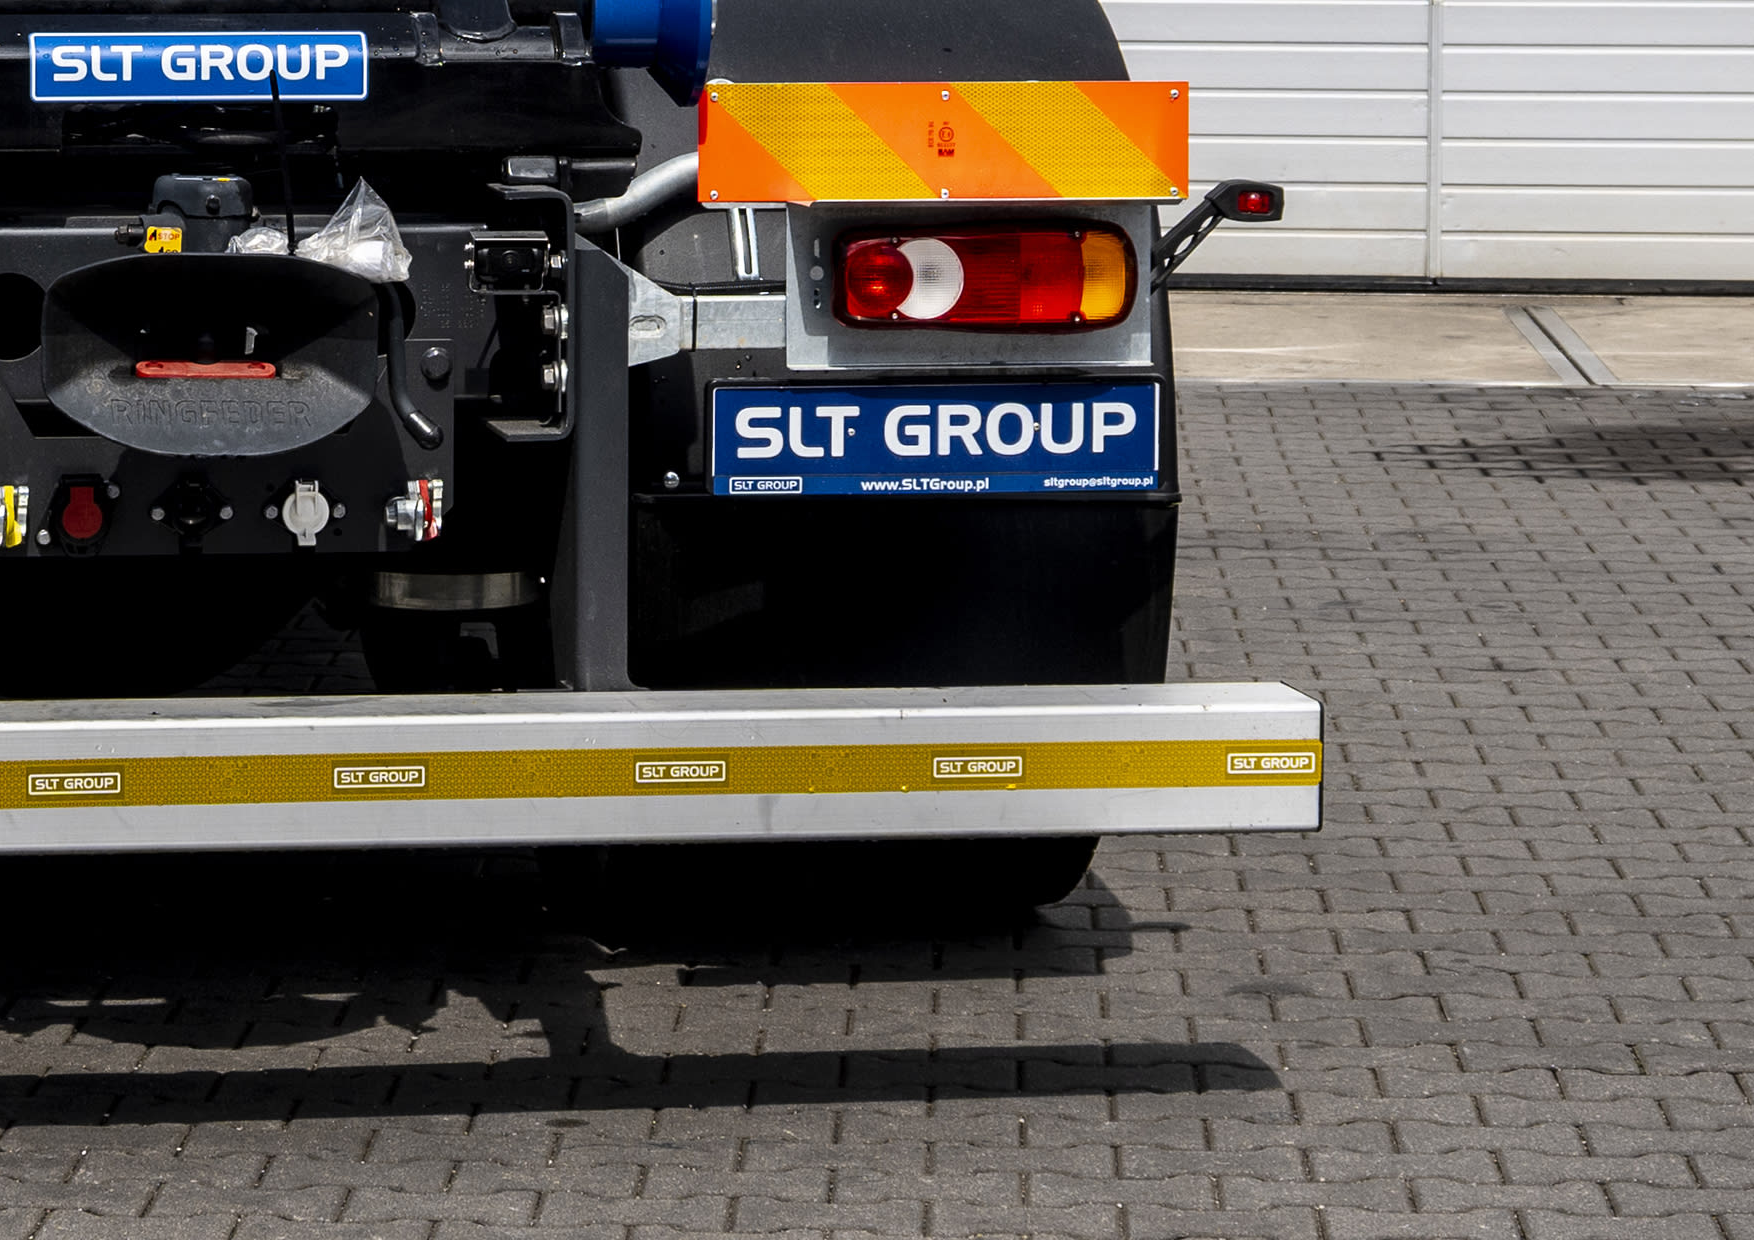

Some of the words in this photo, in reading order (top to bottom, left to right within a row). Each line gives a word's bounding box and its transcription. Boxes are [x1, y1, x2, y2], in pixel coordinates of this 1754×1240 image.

[51, 44, 144, 82] SLT
[160, 43, 350, 81] GROUP
[158, 232, 180, 241] STOP
[110, 398, 312, 427] RINGFEDER
[734, 406, 860, 459] SLT
[883, 402, 1137, 457] GROUP
[733, 480, 754, 491] SLT
[756, 480, 798, 491] GROUP
[860, 477, 990, 492] www.SLTGroup.pl
[1043, 475, 1154, 489] sltgroup@sltgroup.pl
[939, 761, 964, 773] SLT
[967, 761, 1016, 773] GROUP
[1233, 757, 1257, 770] SLT
[1260, 756, 1310, 770] GROUP
[340, 771, 365, 784] SLT
[368, 770, 419, 783] GROUP
[642, 766, 666, 778] SLT
[670, 765, 719, 777] GROUP
[35, 778, 60, 790] SLT
[63, 777, 114, 790] GROUP
